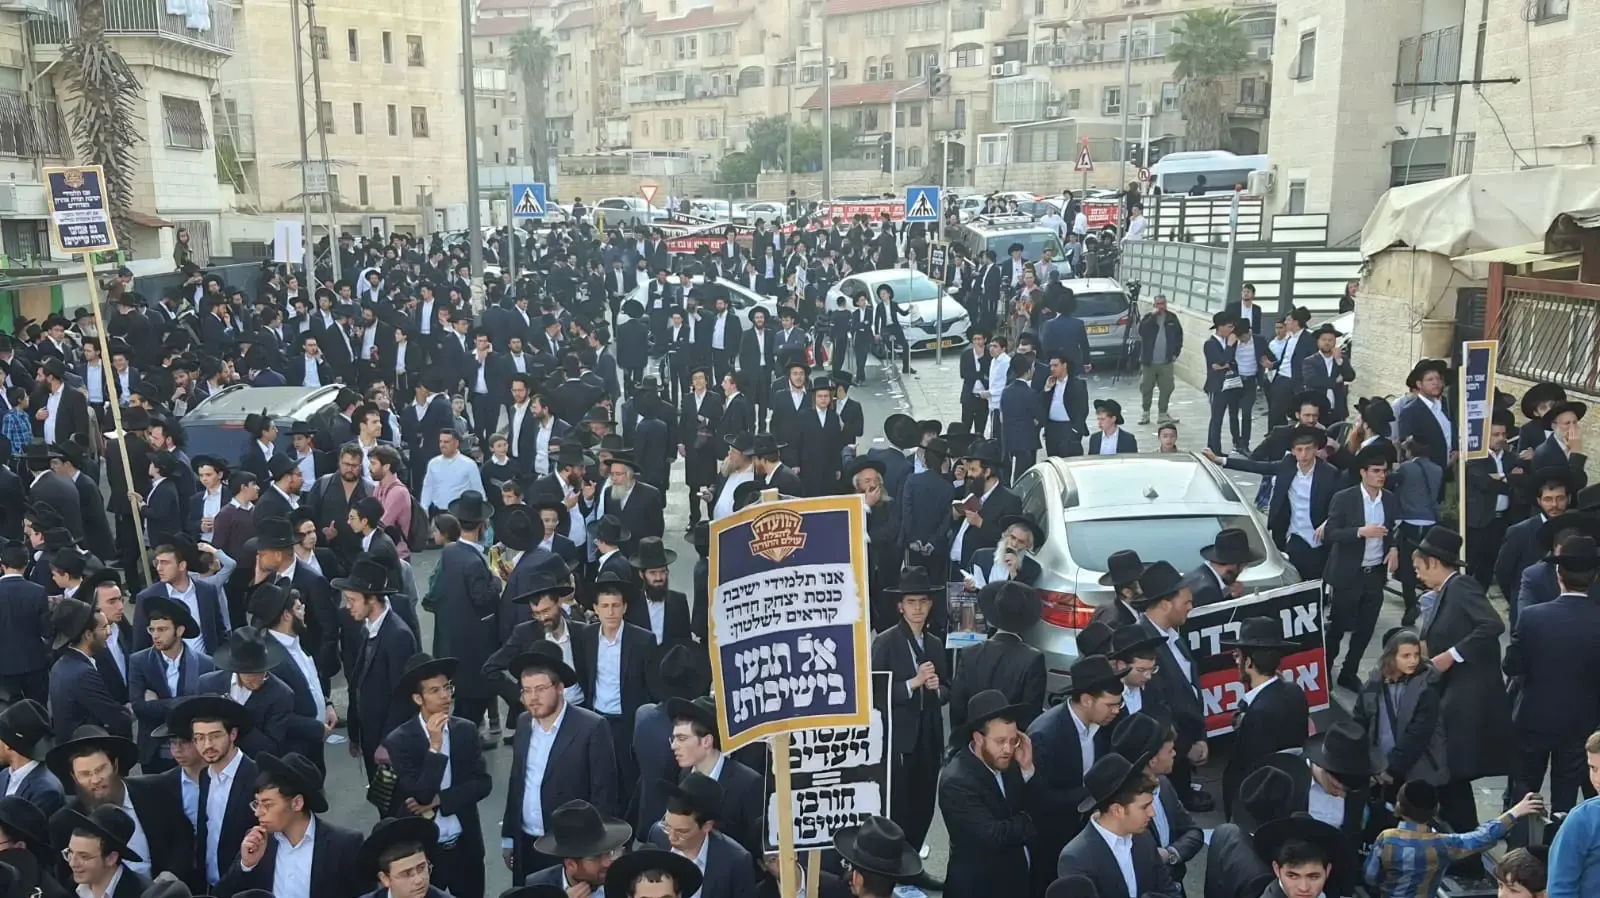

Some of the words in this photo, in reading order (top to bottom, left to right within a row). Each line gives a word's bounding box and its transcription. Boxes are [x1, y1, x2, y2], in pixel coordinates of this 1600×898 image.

[765, 570, 817, 590] תלמידי
[820, 571, 845, 585] אנו
[723, 581, 761, 603] ישיבת
[764, 592, 799, 613] יצחק
[804, 589, 843, 604] כנסת
[726, 599, 760, 620] חדרה
[787, 607, 838, 624] קוראים
[1280, 602, 1319, 639] או
[730, 609, 782, 640] לשלטון:
[1188, 621, 1243, 656] רדי
[735, 642, 792, 685] תגעו
[797, 633, 837, 672] אל
[732, 672, 847, 724] בישיבות!
[796, 788, 855, 816] חורבן
